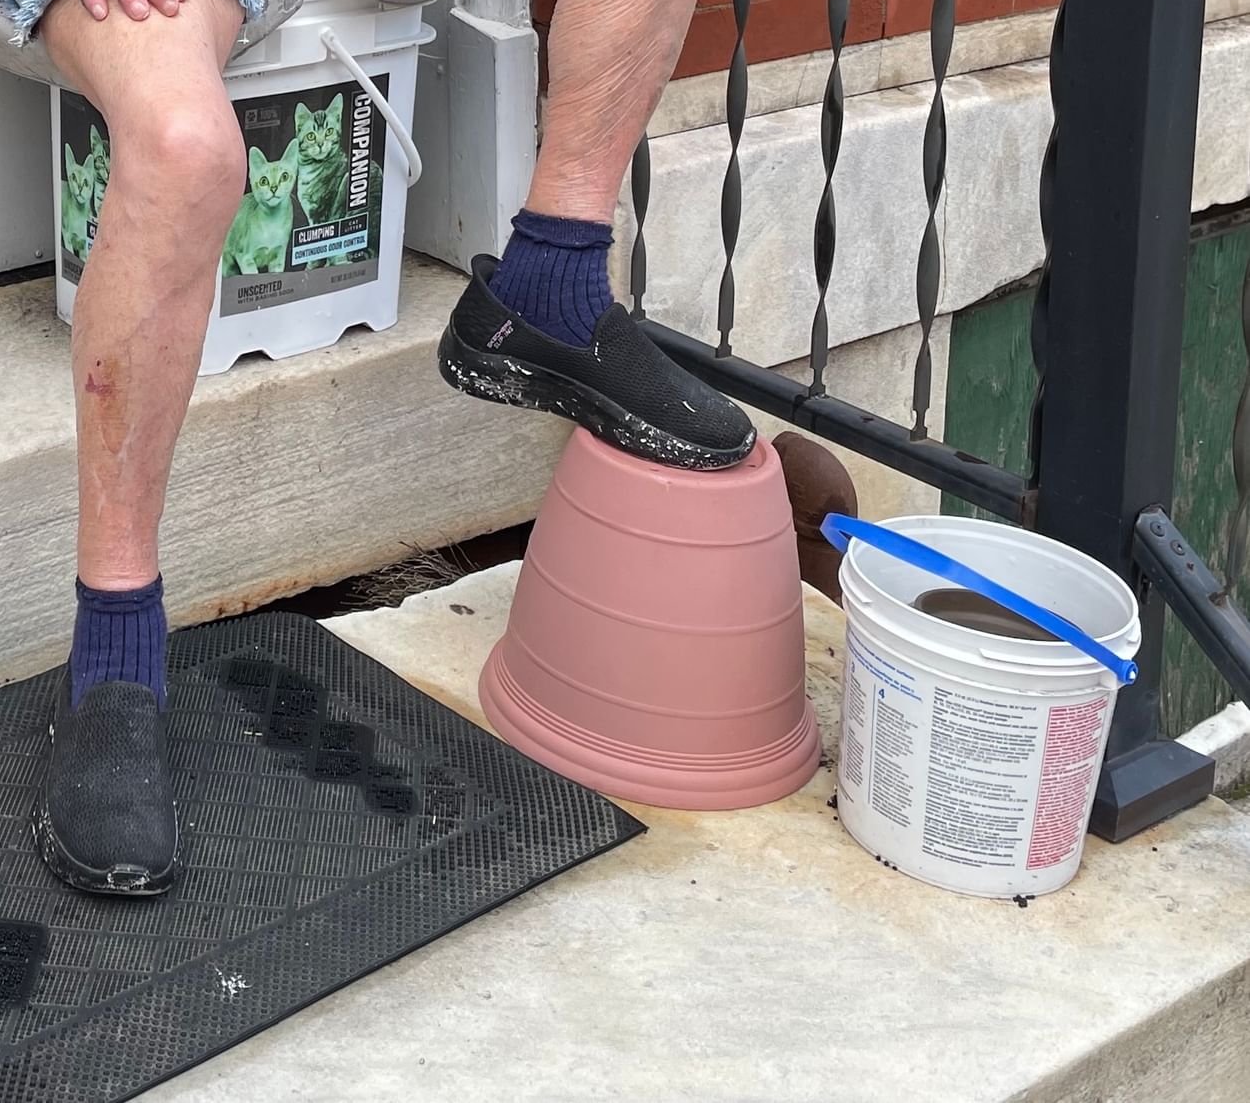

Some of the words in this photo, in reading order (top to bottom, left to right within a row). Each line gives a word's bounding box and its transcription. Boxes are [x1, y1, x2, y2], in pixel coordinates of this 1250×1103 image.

[349, 94, 371, 208] COMPANION
[298, 225, 335, 243] CLUMPING
[237, 280, 283, 299] UNSCENTED
